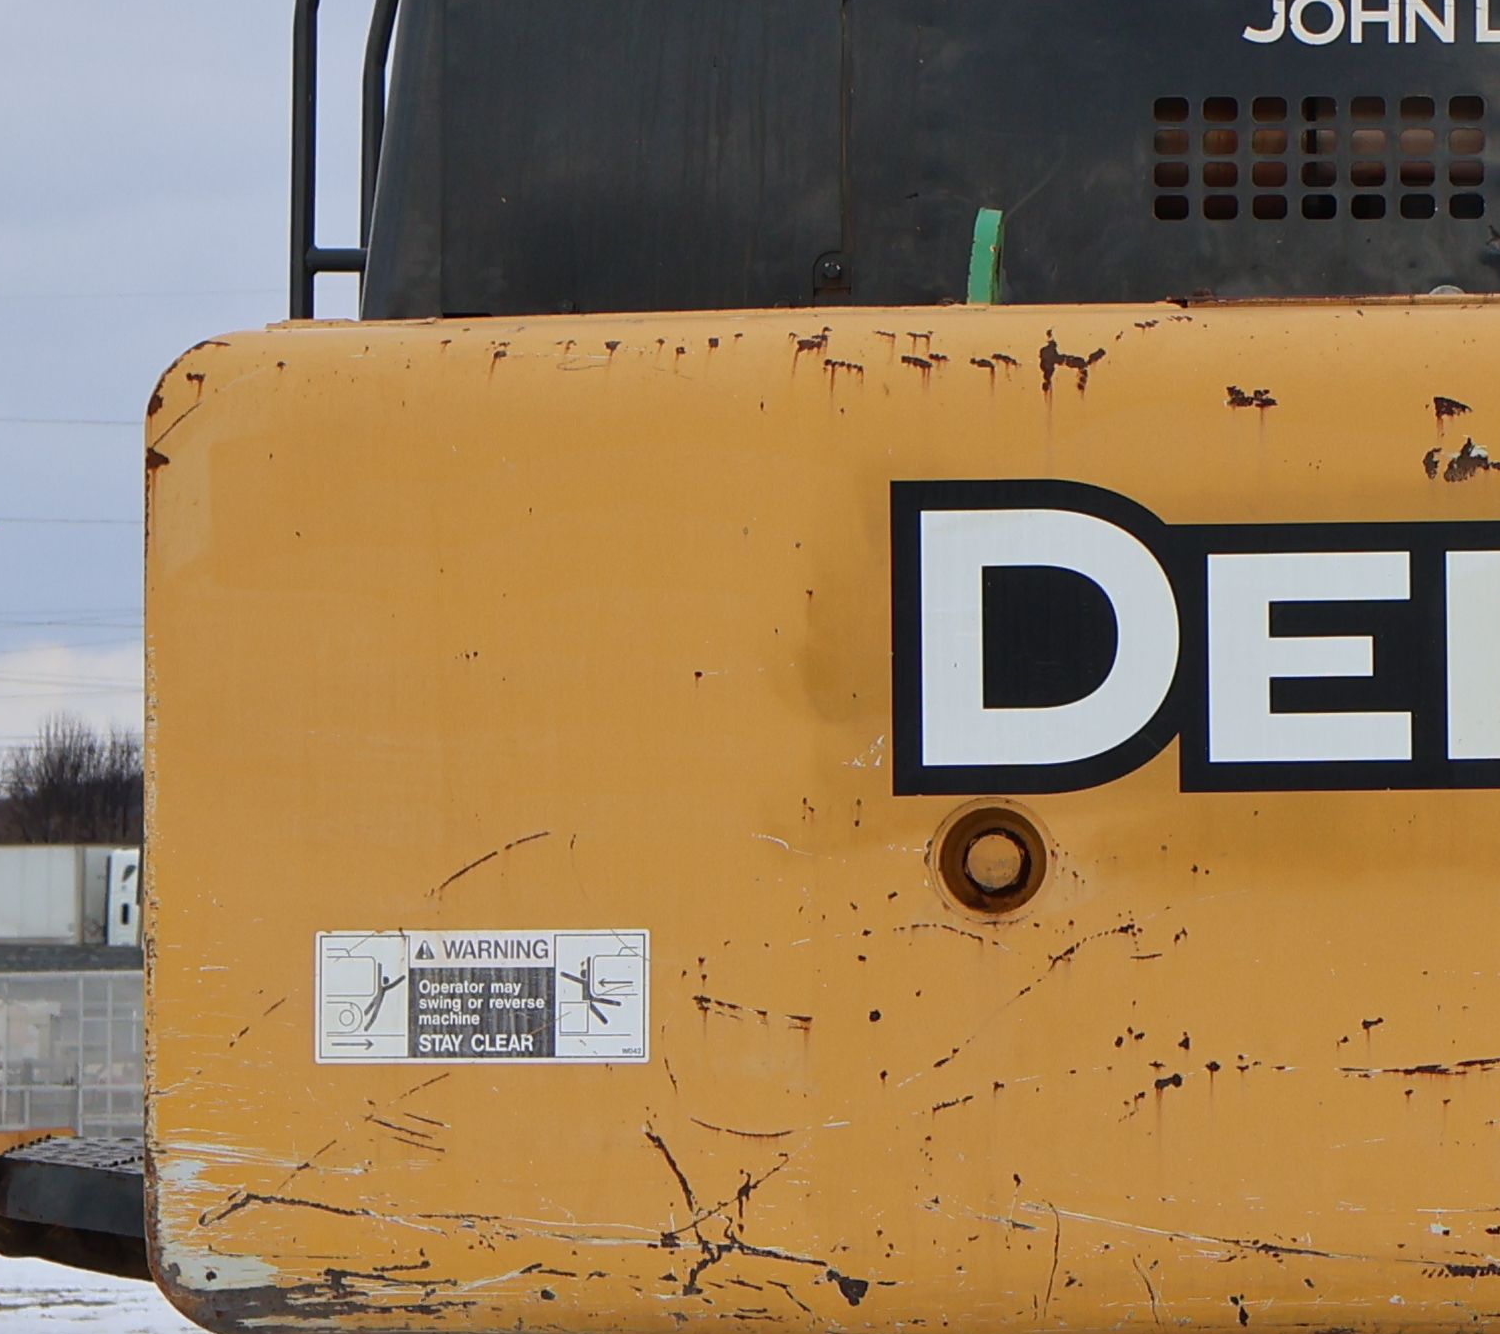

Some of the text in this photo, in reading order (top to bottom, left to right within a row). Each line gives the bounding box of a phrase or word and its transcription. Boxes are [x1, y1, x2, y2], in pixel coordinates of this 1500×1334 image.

[442, 939, 549, 960] WARNING
[418, 979, 522, 996] Operator may
[418, 996, 546, 1012] swing or reverse
[418, 1011, 481, 1026] machine
[418, 1033, 534, 1052] STAY CLEAR
